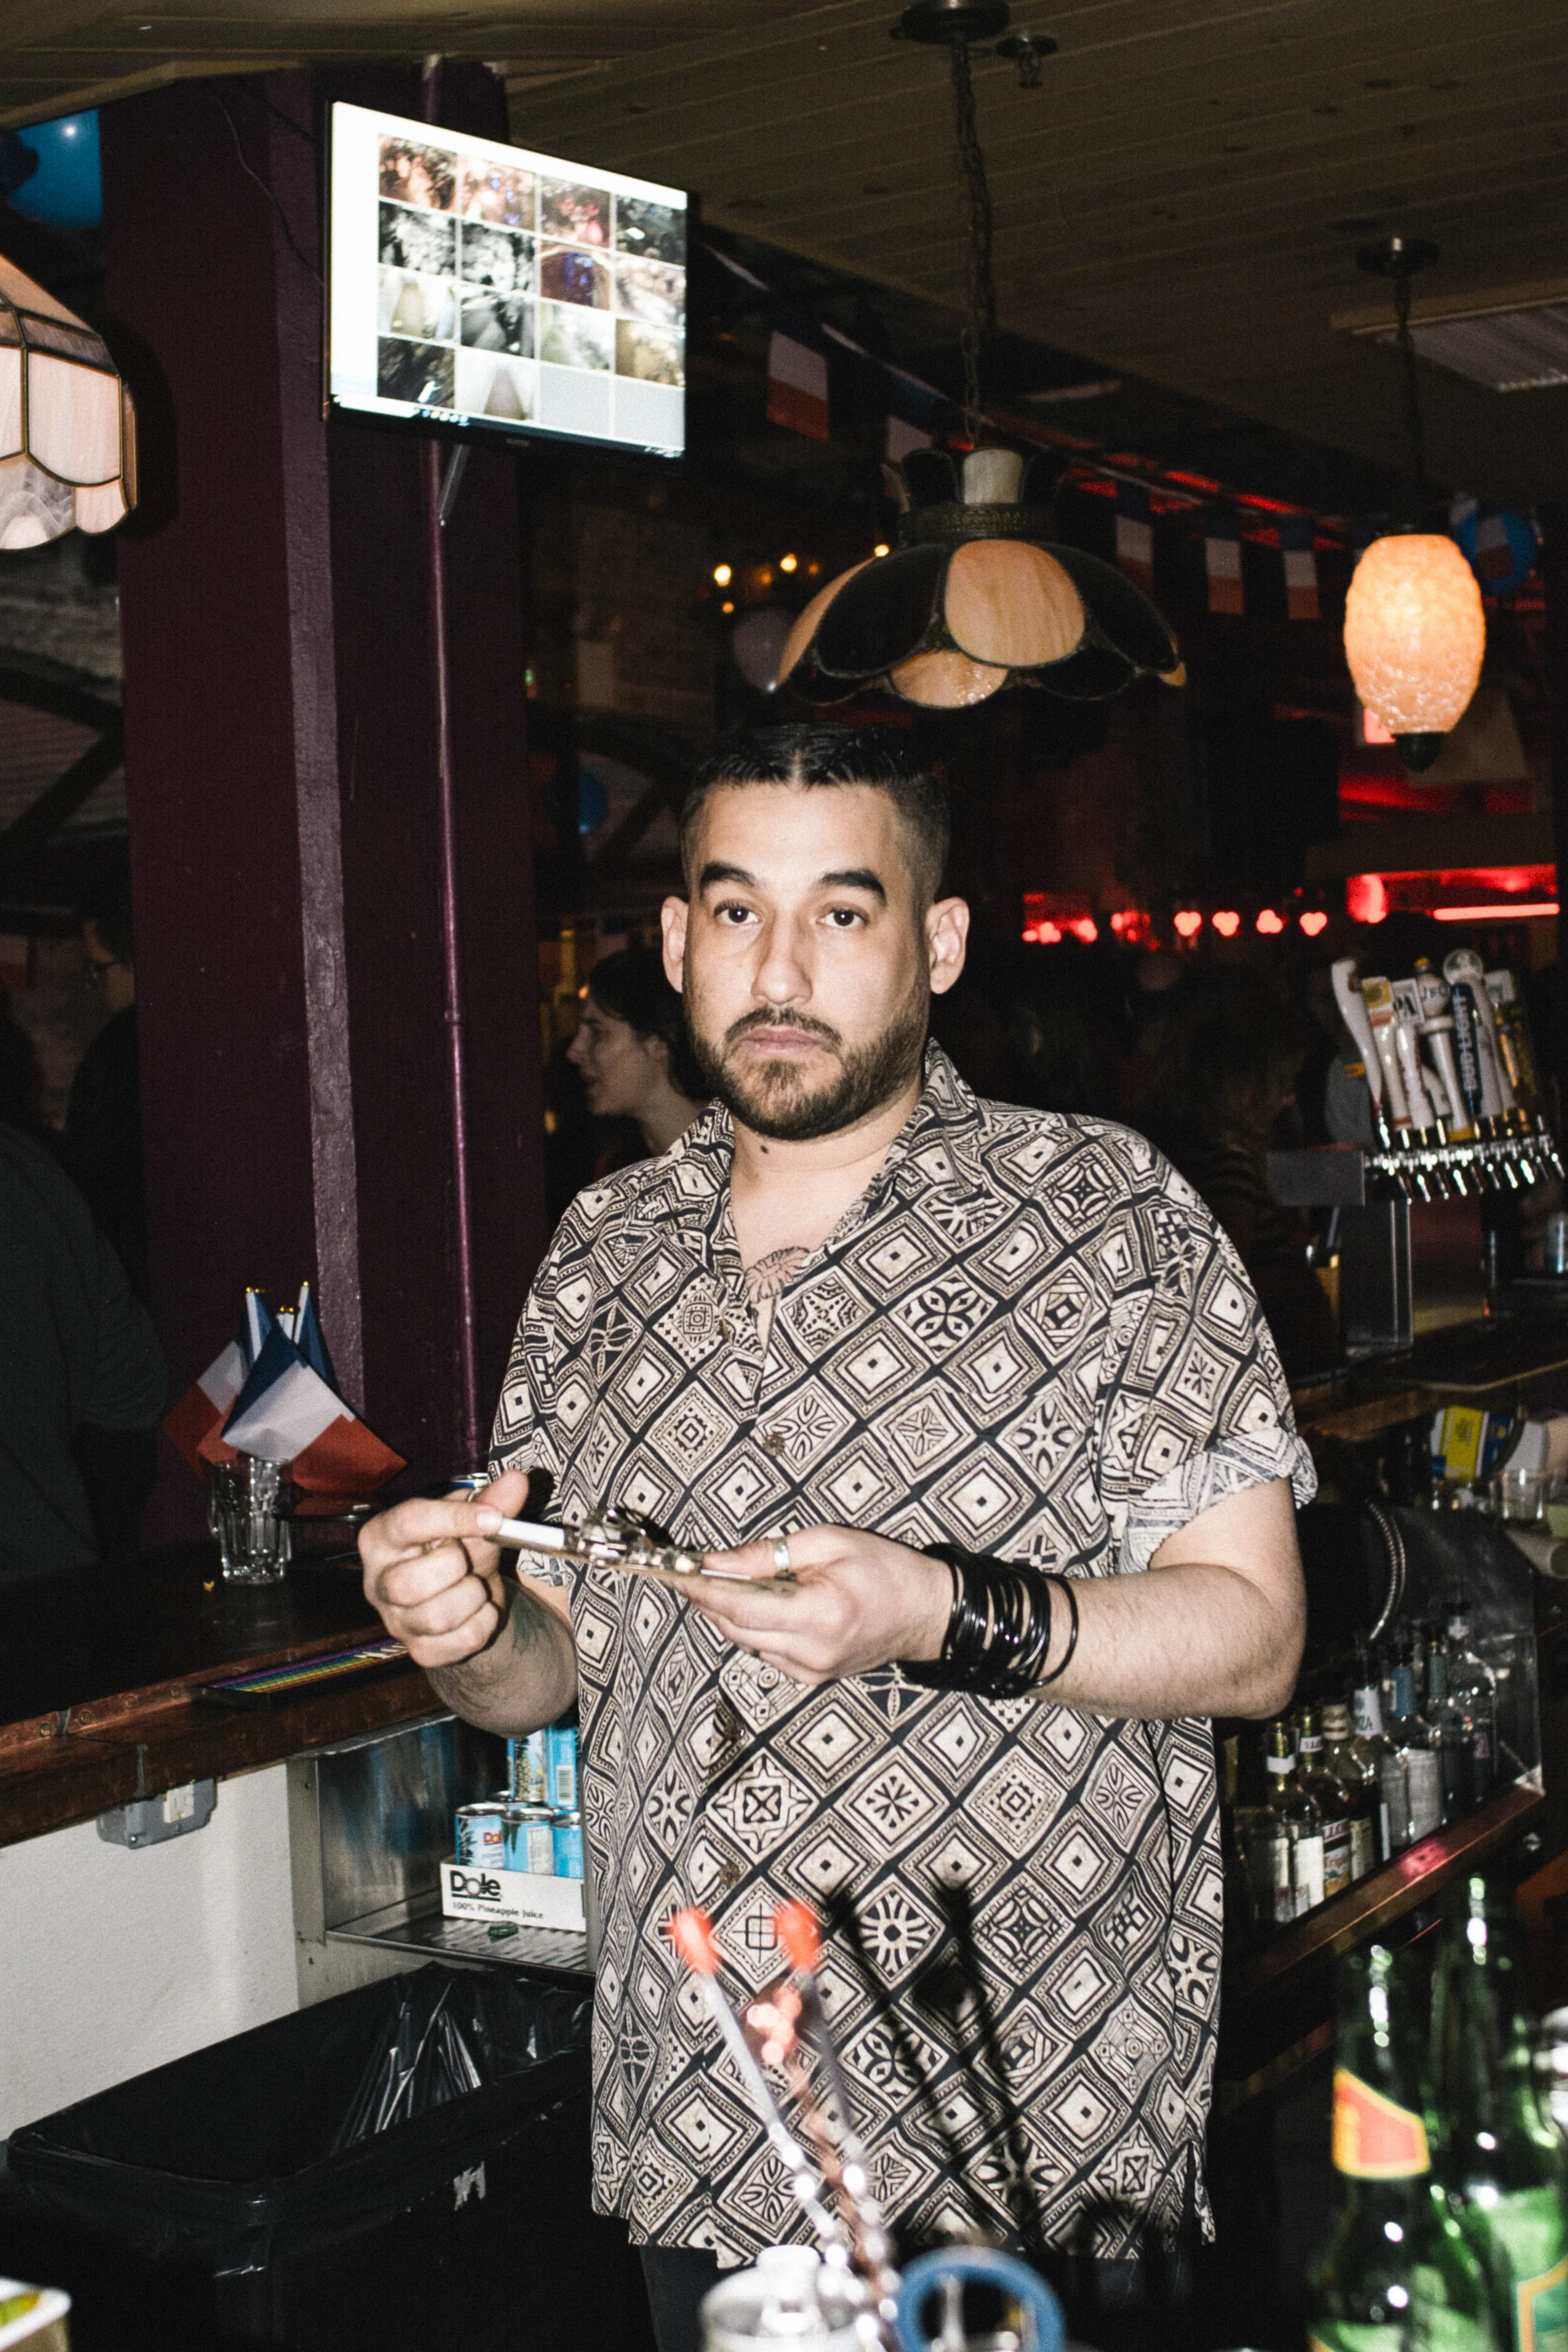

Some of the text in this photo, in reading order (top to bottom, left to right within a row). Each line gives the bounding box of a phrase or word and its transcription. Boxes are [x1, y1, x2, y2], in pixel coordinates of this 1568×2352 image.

[450, 1870, 501, 1897] Dole
[453, 1902, 544, 1919] 100% Pineapple Juice
